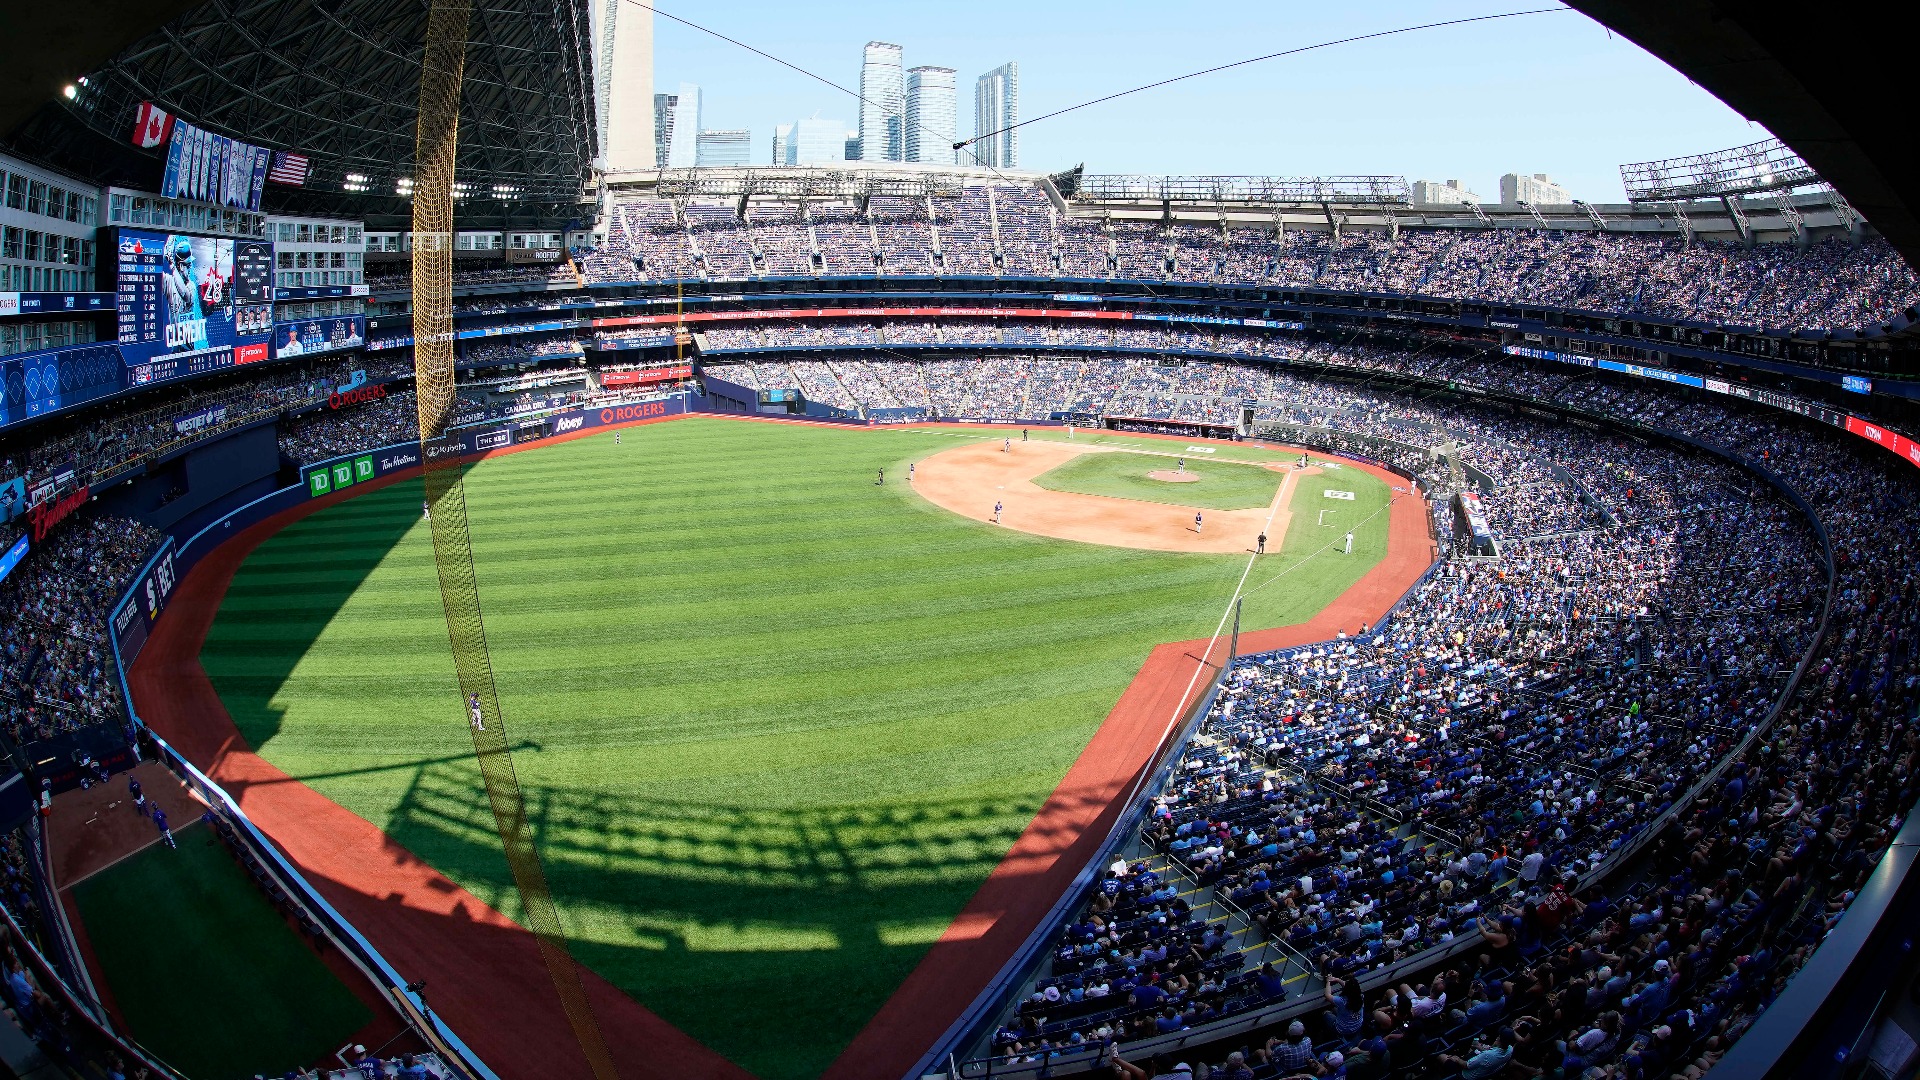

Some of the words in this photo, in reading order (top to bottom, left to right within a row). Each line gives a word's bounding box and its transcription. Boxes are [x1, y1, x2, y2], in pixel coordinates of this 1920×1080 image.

[165, 319, 207, 348] CLEMENT
[343, 383, 386, 406] ROGERS
[504, 403, 532, 414] CANADA
[616, 402, 665, 420] ROGERS
[175, 414, 206, 433] WESTJET
[556, 416, 584, 433] sobeys
[439, 442, 467, 453] Kubota
[357, 460, 372, 477] TD
[381, 459, 392, 471] Tim
[393, 454, 417, 467] Hortons
[311, 474, 328, 491] TD
[334, 467, 350, 484] TD
[157, 552, 175, 598] BET
